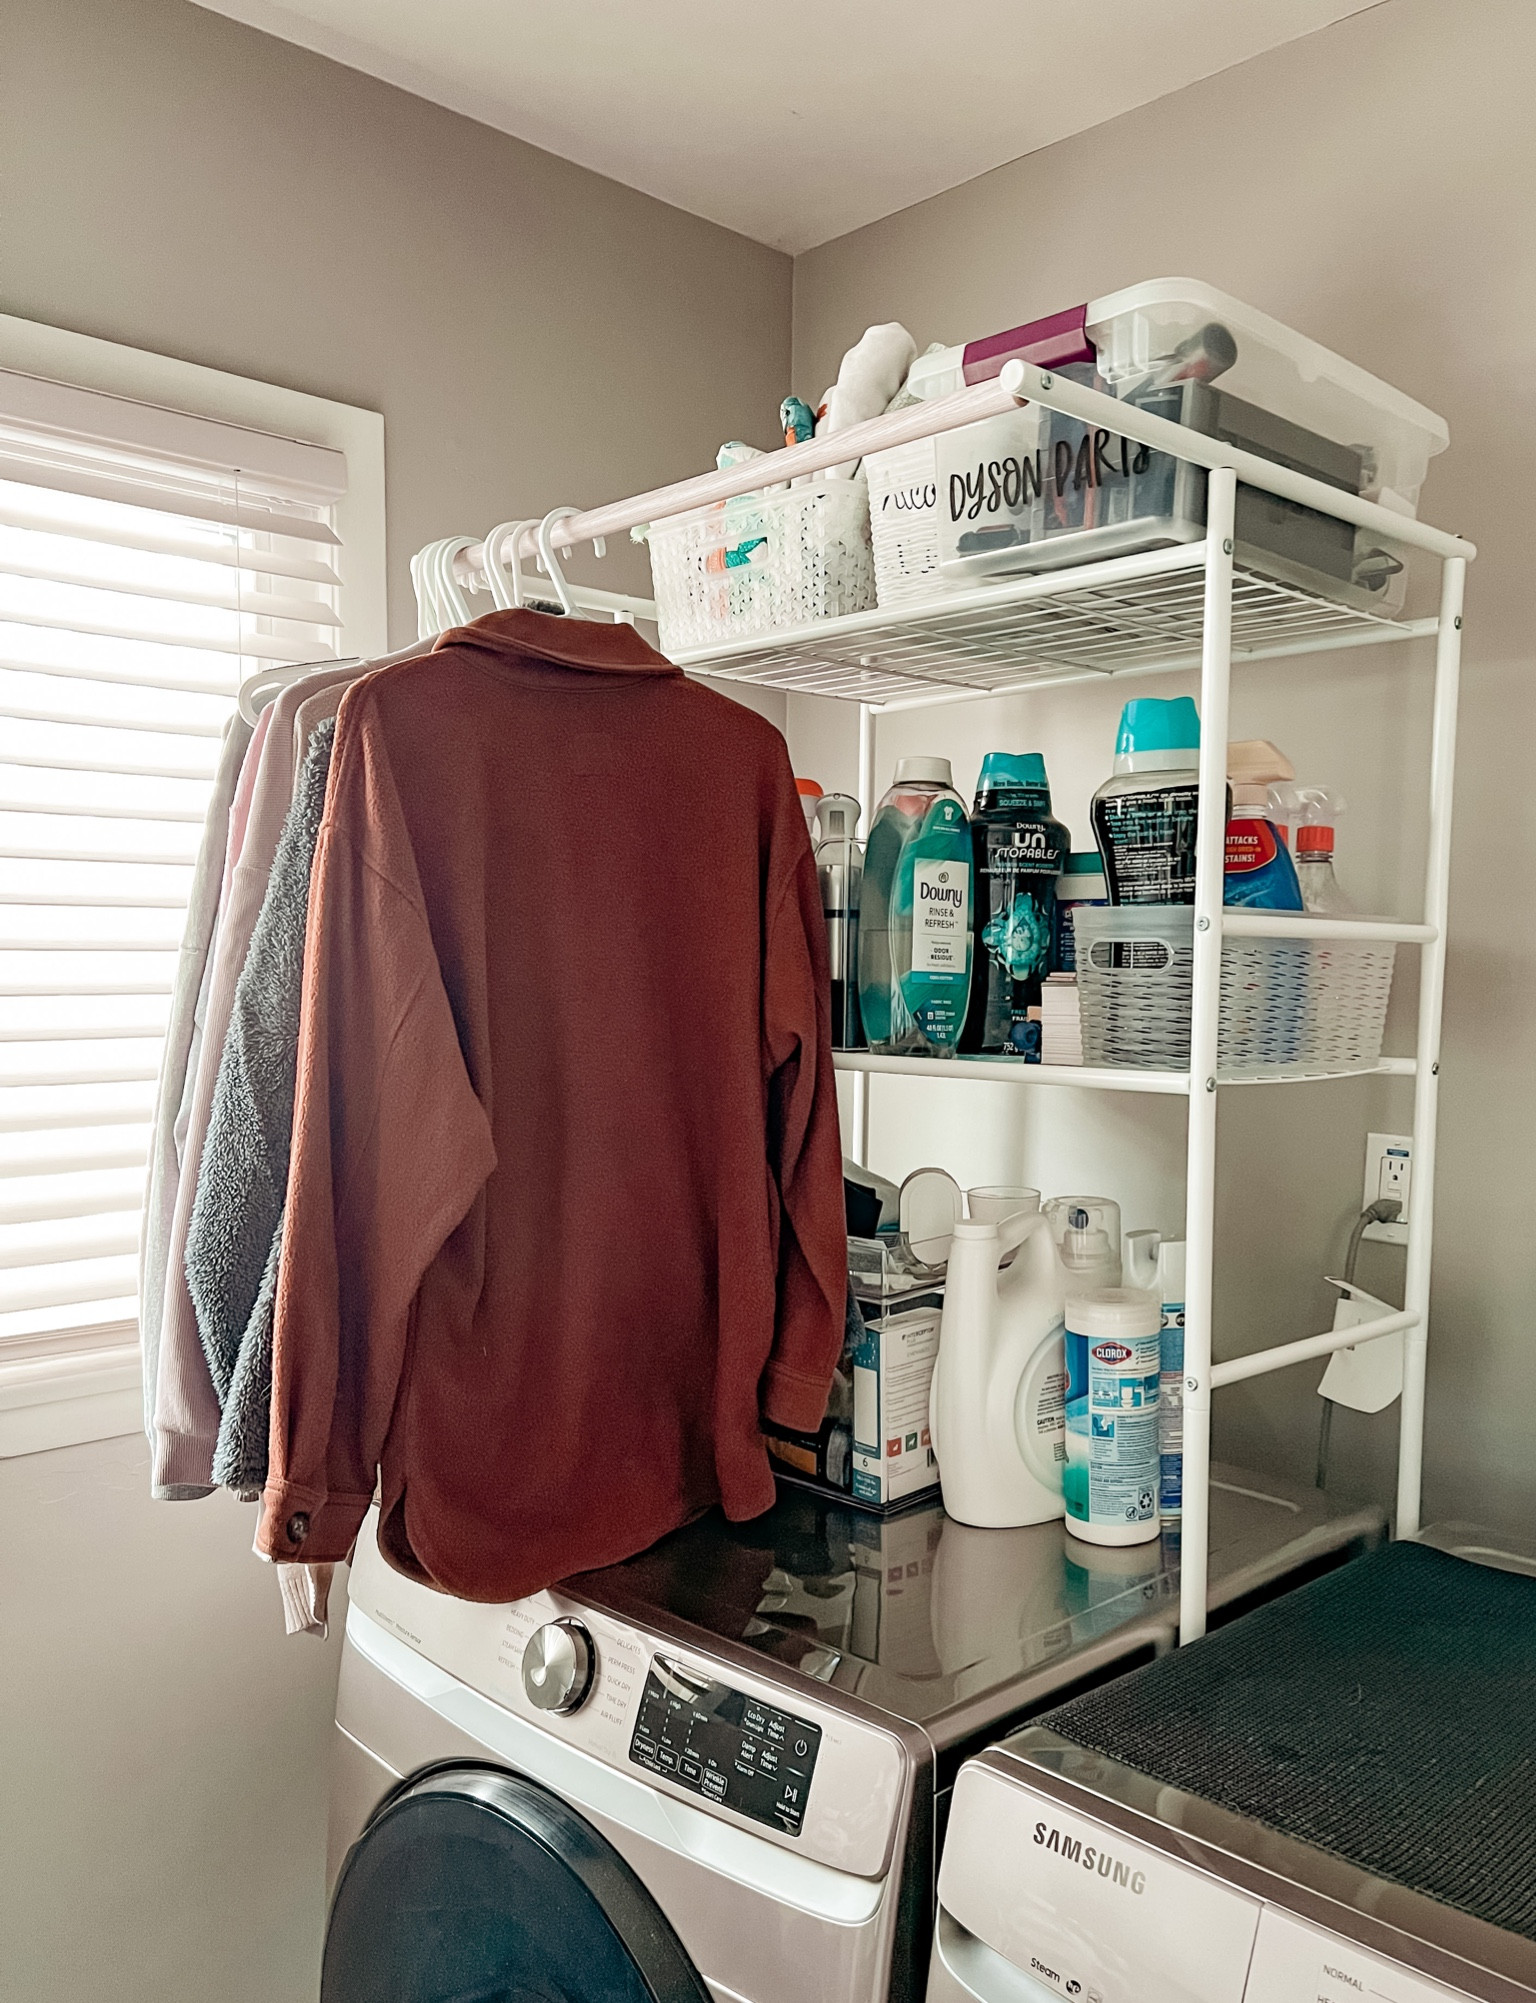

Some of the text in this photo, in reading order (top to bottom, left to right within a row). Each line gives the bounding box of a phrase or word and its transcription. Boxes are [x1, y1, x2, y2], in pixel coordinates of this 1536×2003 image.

[949, 448, 1042, 522] DYSON
[1054, 428, 1150, 497] PARTS
[1016, 822, 1045, 832] Downy
[1225, 836, 1258, 844] ATTACKS
[995, 848, 1060, 859] STOPABLES
[1224, 854, 1256, 863] STAINS!
[920, 882, 962, 908] Downy
[929, 907, 954, 917] RINSE &
[925, 919, 955, 929] REFRESH
[1096, 1347, 1127, 1359] CLOROX
[862, 1457, 869, 1467] 6
[616, 1638, 641, 1656] DELICATES
[607, 1656, 636, 1675] PERM PRESS
[606, 1674, 631, 1692] QUICK DRY
[617, 1699, 627, 1709] DRY
[747, 1709, 766, 1725] Eco Dry
[768, 1720, 785, 1733] Adjust
[767, 1727, 780, 1740] Time
[635, 1738, 654, 1754] Dryness
[741, 1740, 757, 1753] Damp
[659, 1750, 674, 1765] Temp.
[740, 1749, 754, 1761] Alert
[761, 1750, 778, 1763] Adjust
[684, 1763, 697, 1776] Time
[760, 1758, 773, 1770] Time
[705, 1770, 725, 1786] Wrinkle
[703, 1778, 724, 1794] Prevent
[789, 1808, 800, 1818] Start
[1033, 1822, 1147, 1895] SAMSUNG
[1030, 1957, 1061, 1983] Steam
[1322, 1964, 1364, 1992] NORMAL
